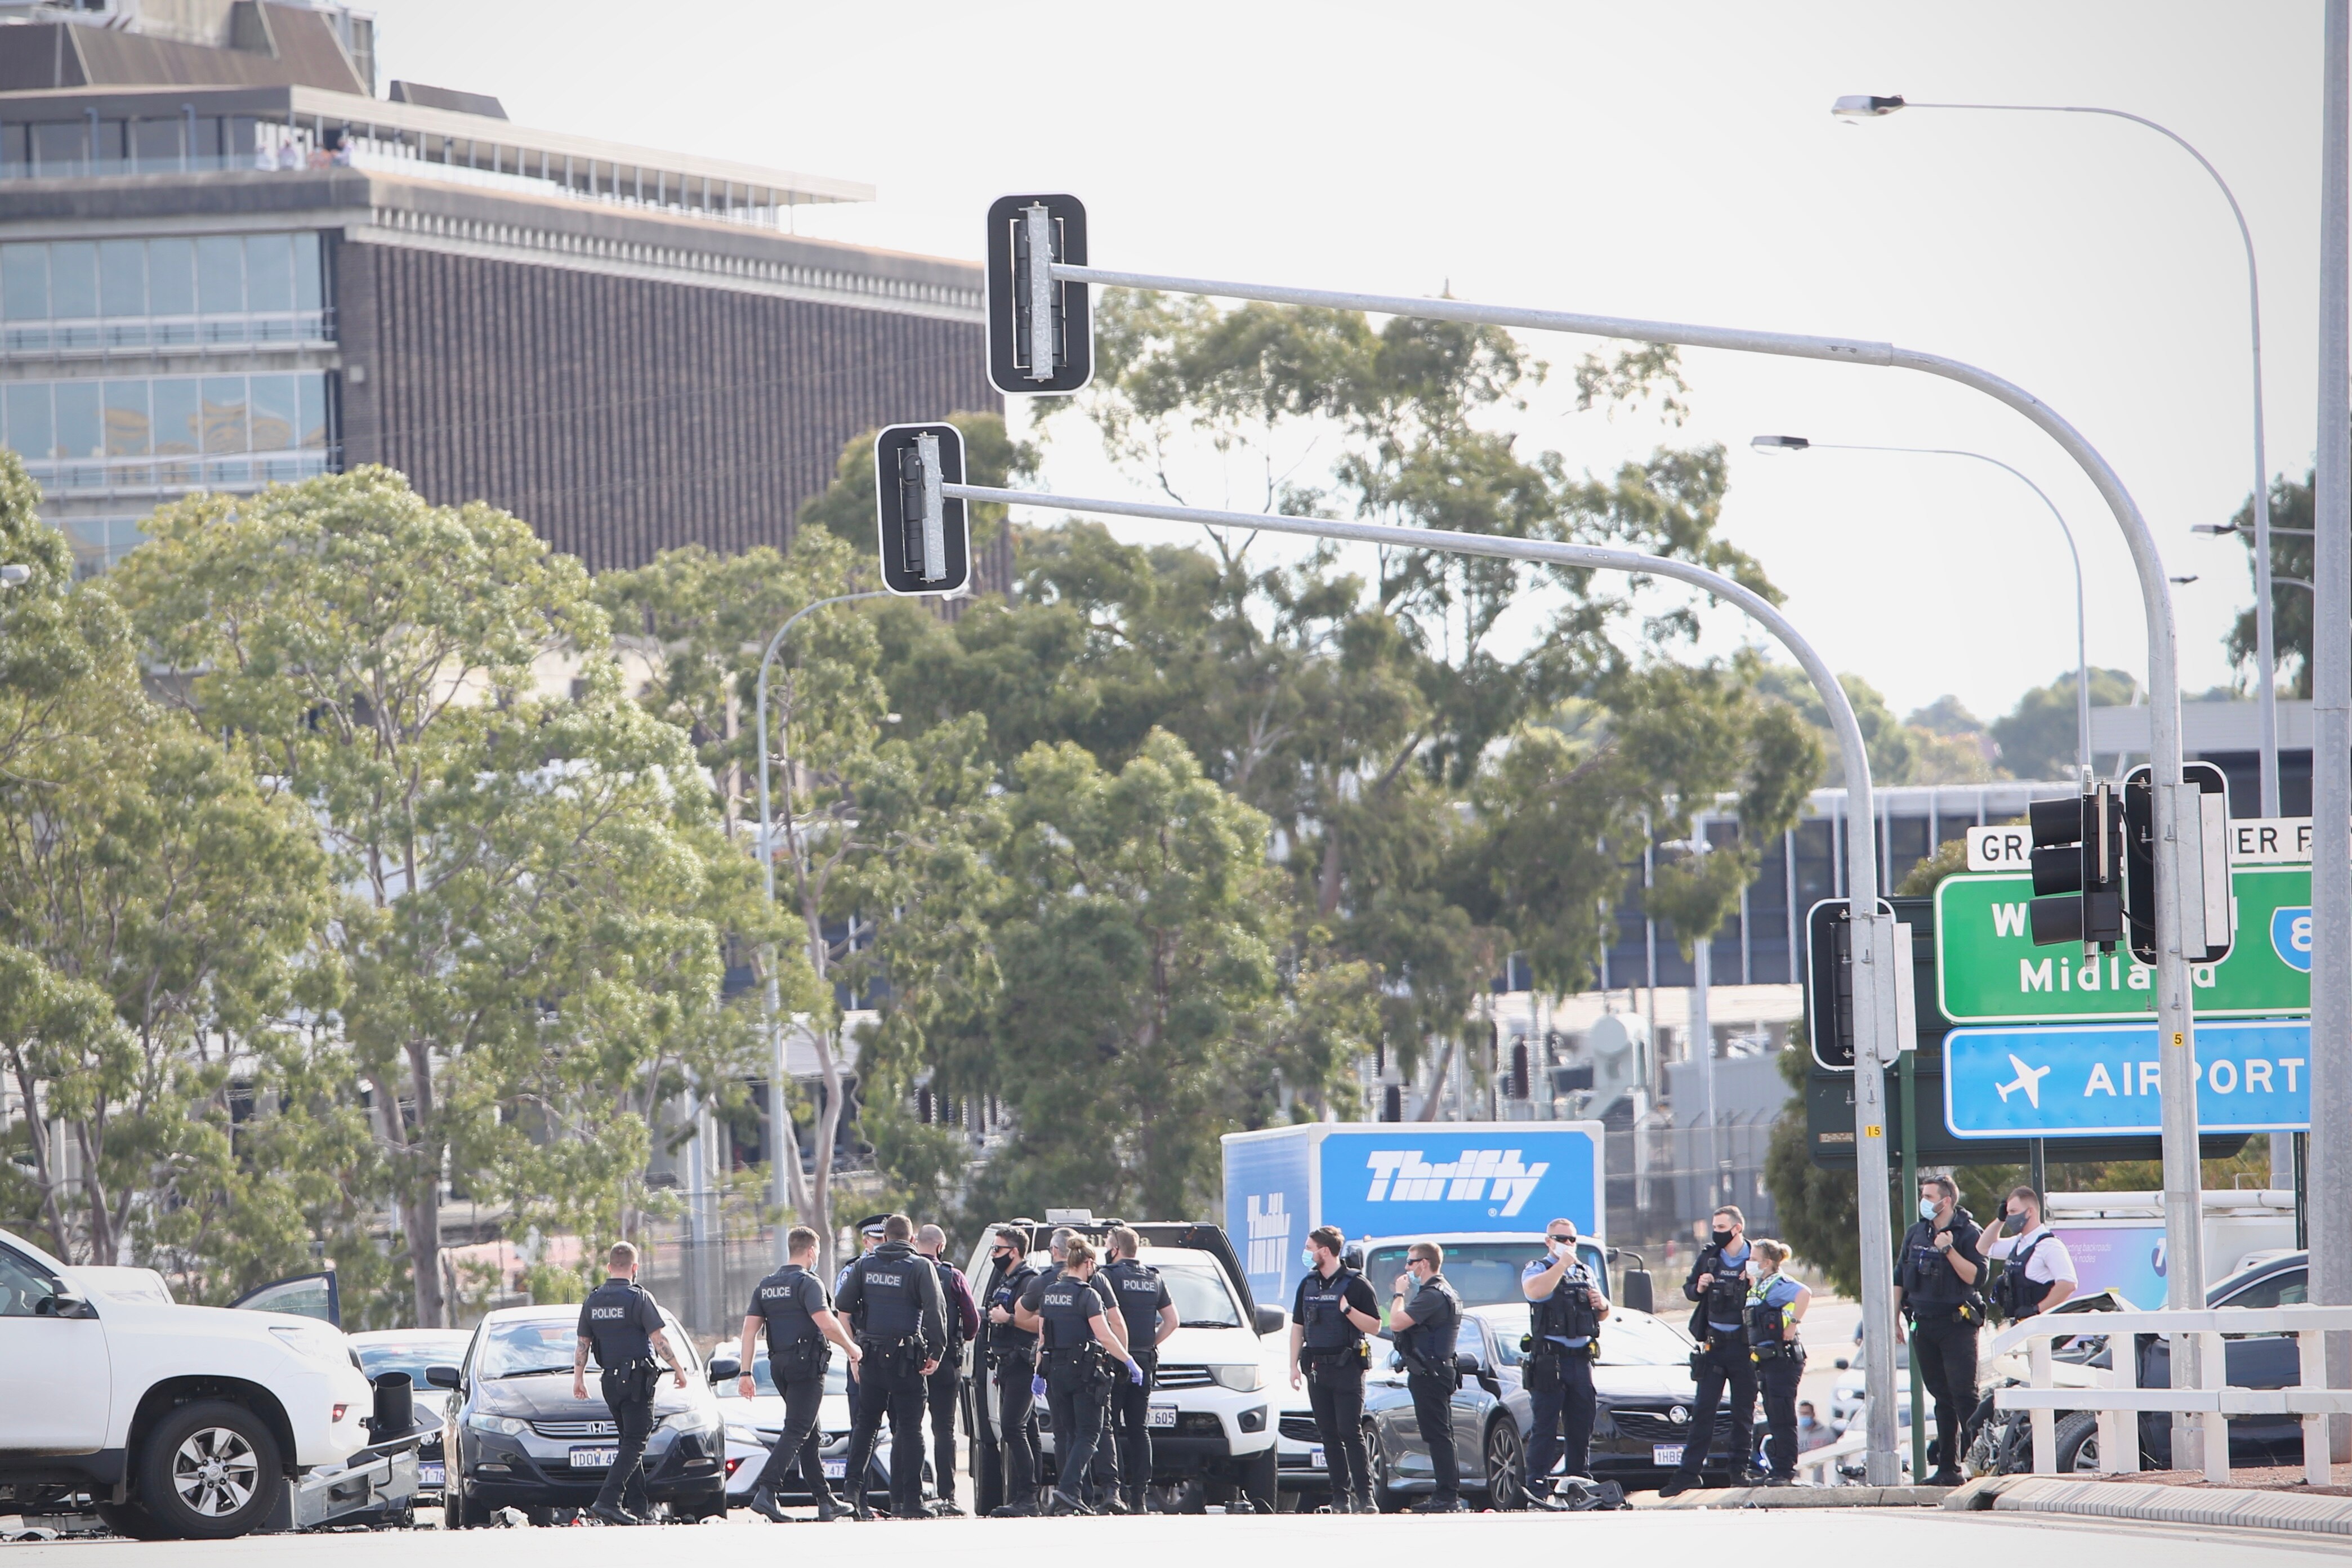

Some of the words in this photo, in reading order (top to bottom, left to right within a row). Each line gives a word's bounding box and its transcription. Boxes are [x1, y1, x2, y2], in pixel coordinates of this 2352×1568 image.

[1981, 834, 2024, 861] GR
[2230, 827, 2278, 854] ER
[2297, 825, 2312, 852] F
[1992, 903, 2027, 937] W
[2020, 957, 2216, 993] Midlad
[2174, 1034, 2182, 1044] 5
[2083, 1058, 2305, 1097] AIRORT
[1366, 1149, 1550, 1217] Thrifty
[1247, 1192, 1291, 1299] Thrifty
[2082, 1243, 2112, 1252] backroads
[2078, 1253, 2096, 1262] nodes
[865, 1273, 900, 1286] POLICE
[1123, 1280, 1155, 1291] POLICE
[761, 1286, 791, 1298] POLICE
[1045, 1294, 1072, 1305] POLICE
[592, 1307, 623, 1319] POLICE
[1315, 1454, 1325, 1465] 1G
[1657, 1451, 1682, 1463] 1HBE
